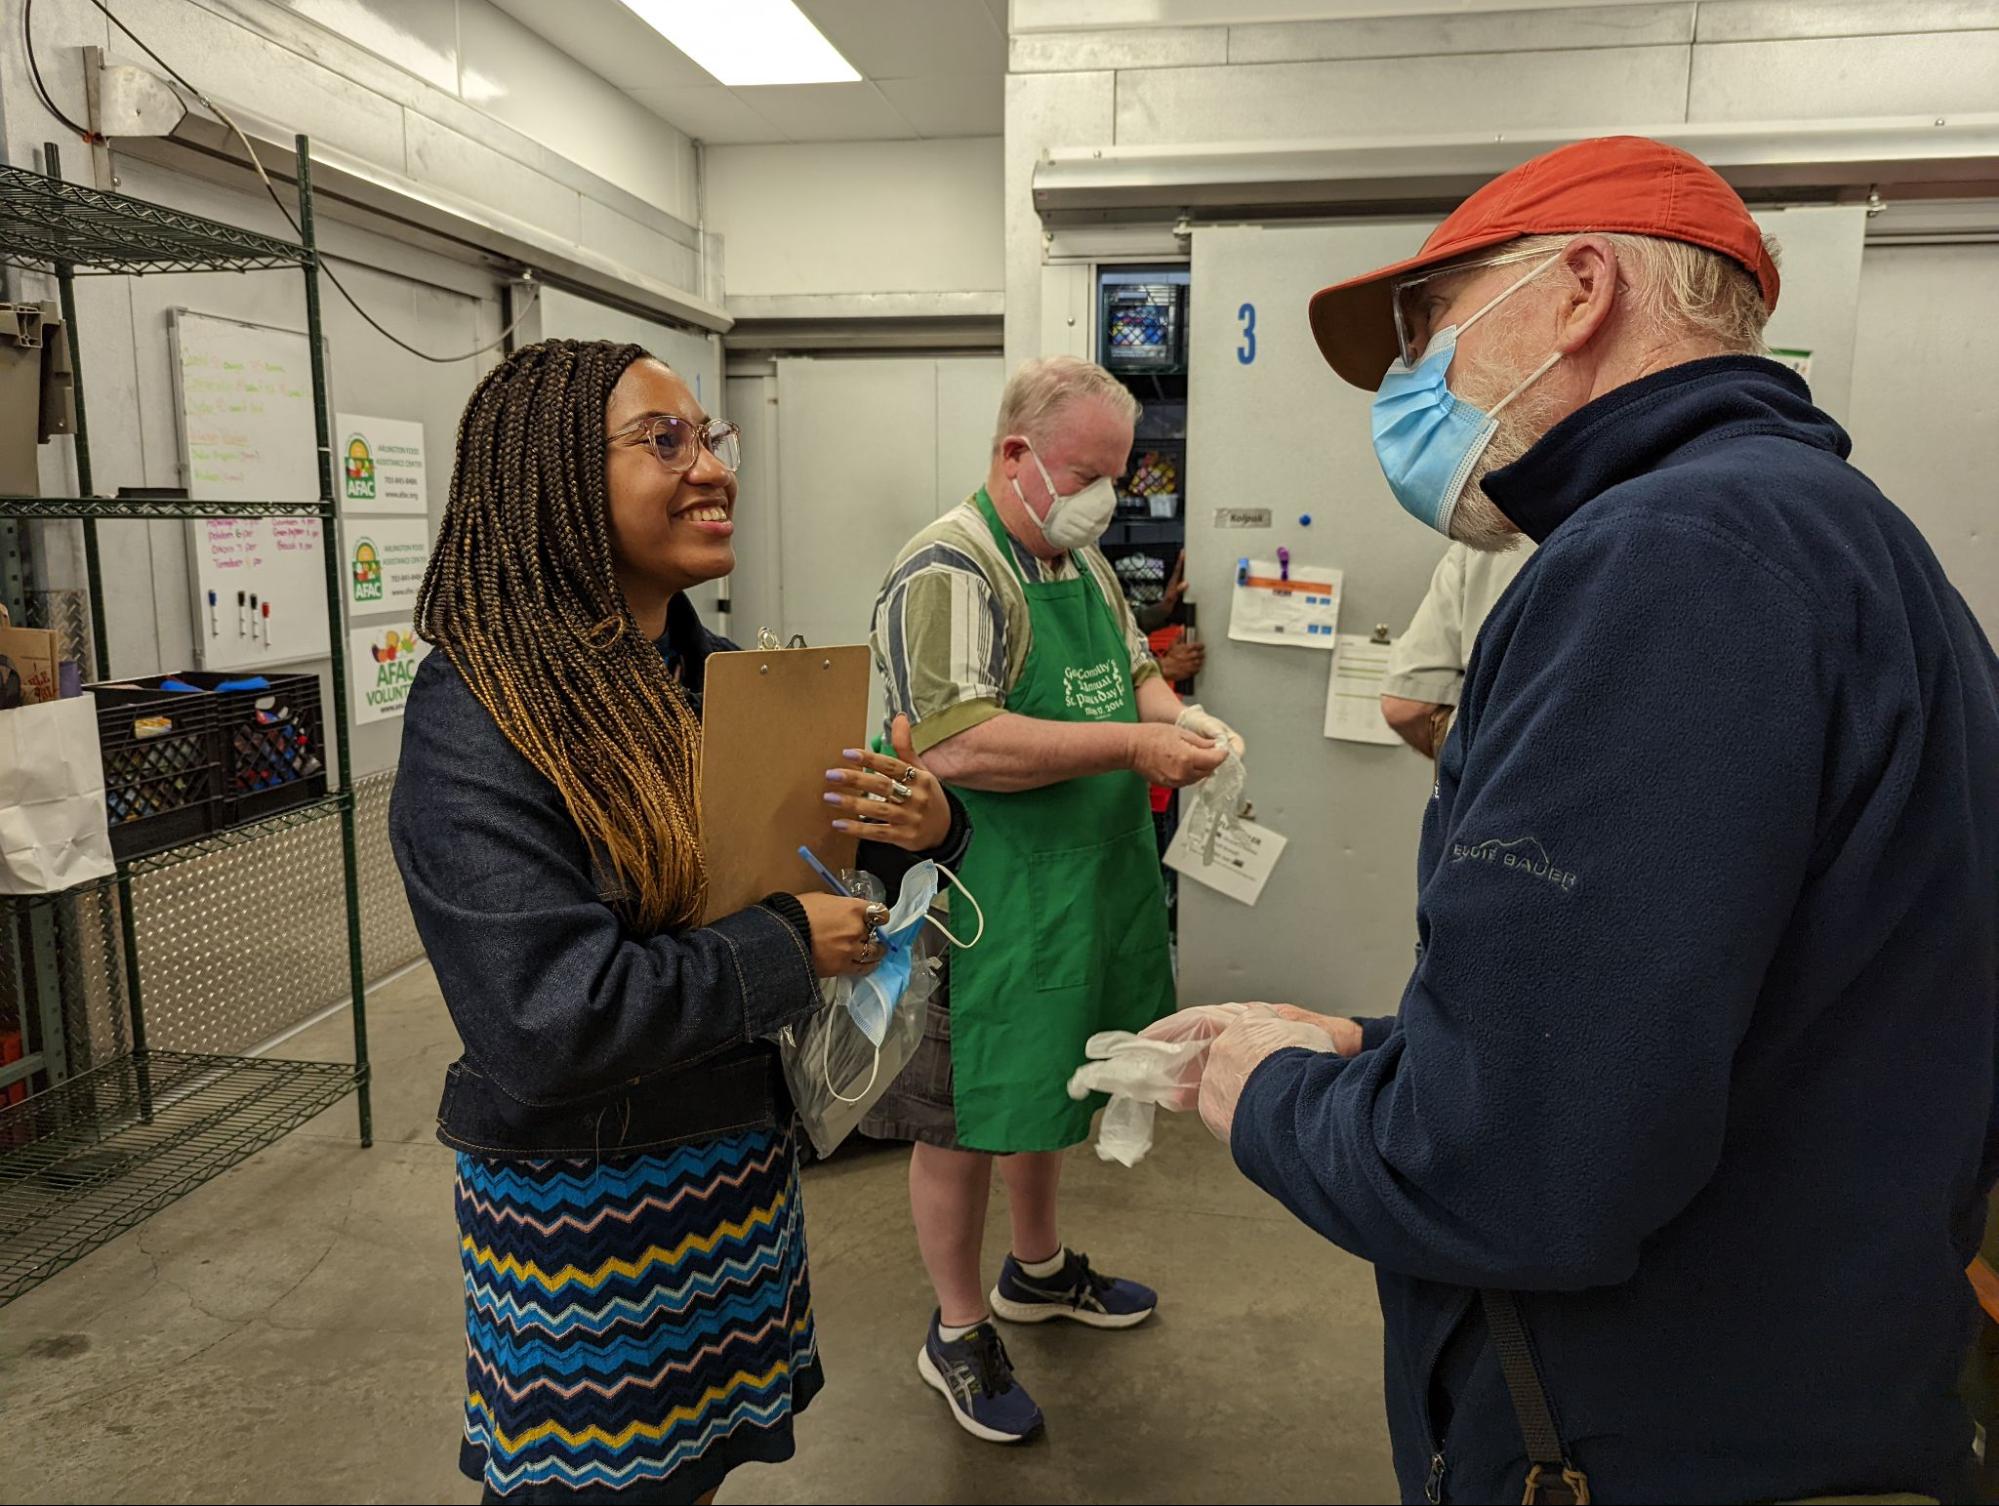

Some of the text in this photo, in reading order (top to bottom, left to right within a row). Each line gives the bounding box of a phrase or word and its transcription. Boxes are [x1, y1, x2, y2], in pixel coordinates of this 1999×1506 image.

[1237, 303, 1256, 365] 3
[348, 481, 375, 497] AFAC
[356, 582, 381, 599] AFAC
[377, 658, 415, 687] AFAC
[366, 684, 411, 706] VOLUNT
[1105, 699, 1124, 713] 2014
[1503, 853, 1577, 891] BAUER
